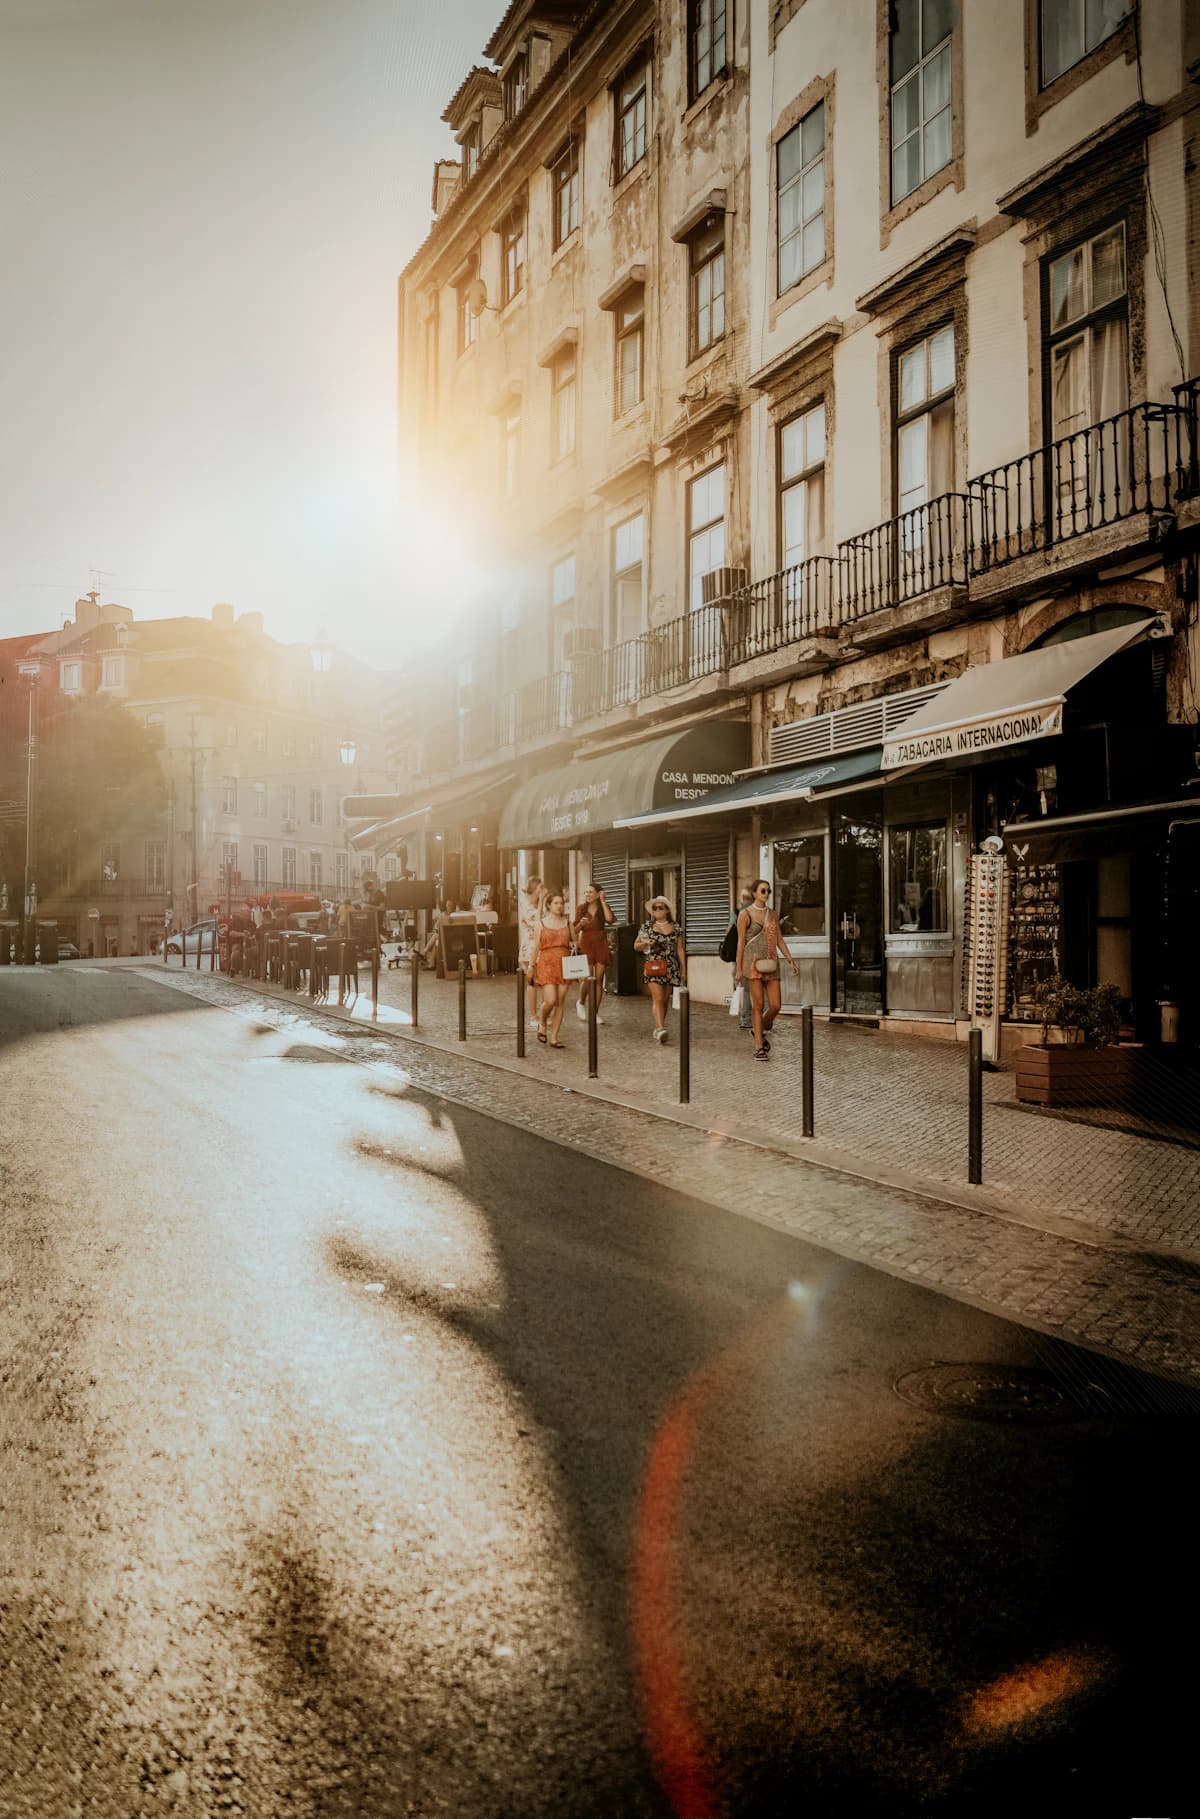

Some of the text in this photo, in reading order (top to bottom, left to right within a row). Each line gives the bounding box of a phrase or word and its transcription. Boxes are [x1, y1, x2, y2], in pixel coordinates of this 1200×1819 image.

[898, 737, 952, 762] TABACARIA
[957, 715, 1044, 750] INTERNACIONAL
[662, 772, 689, 783] CASA
